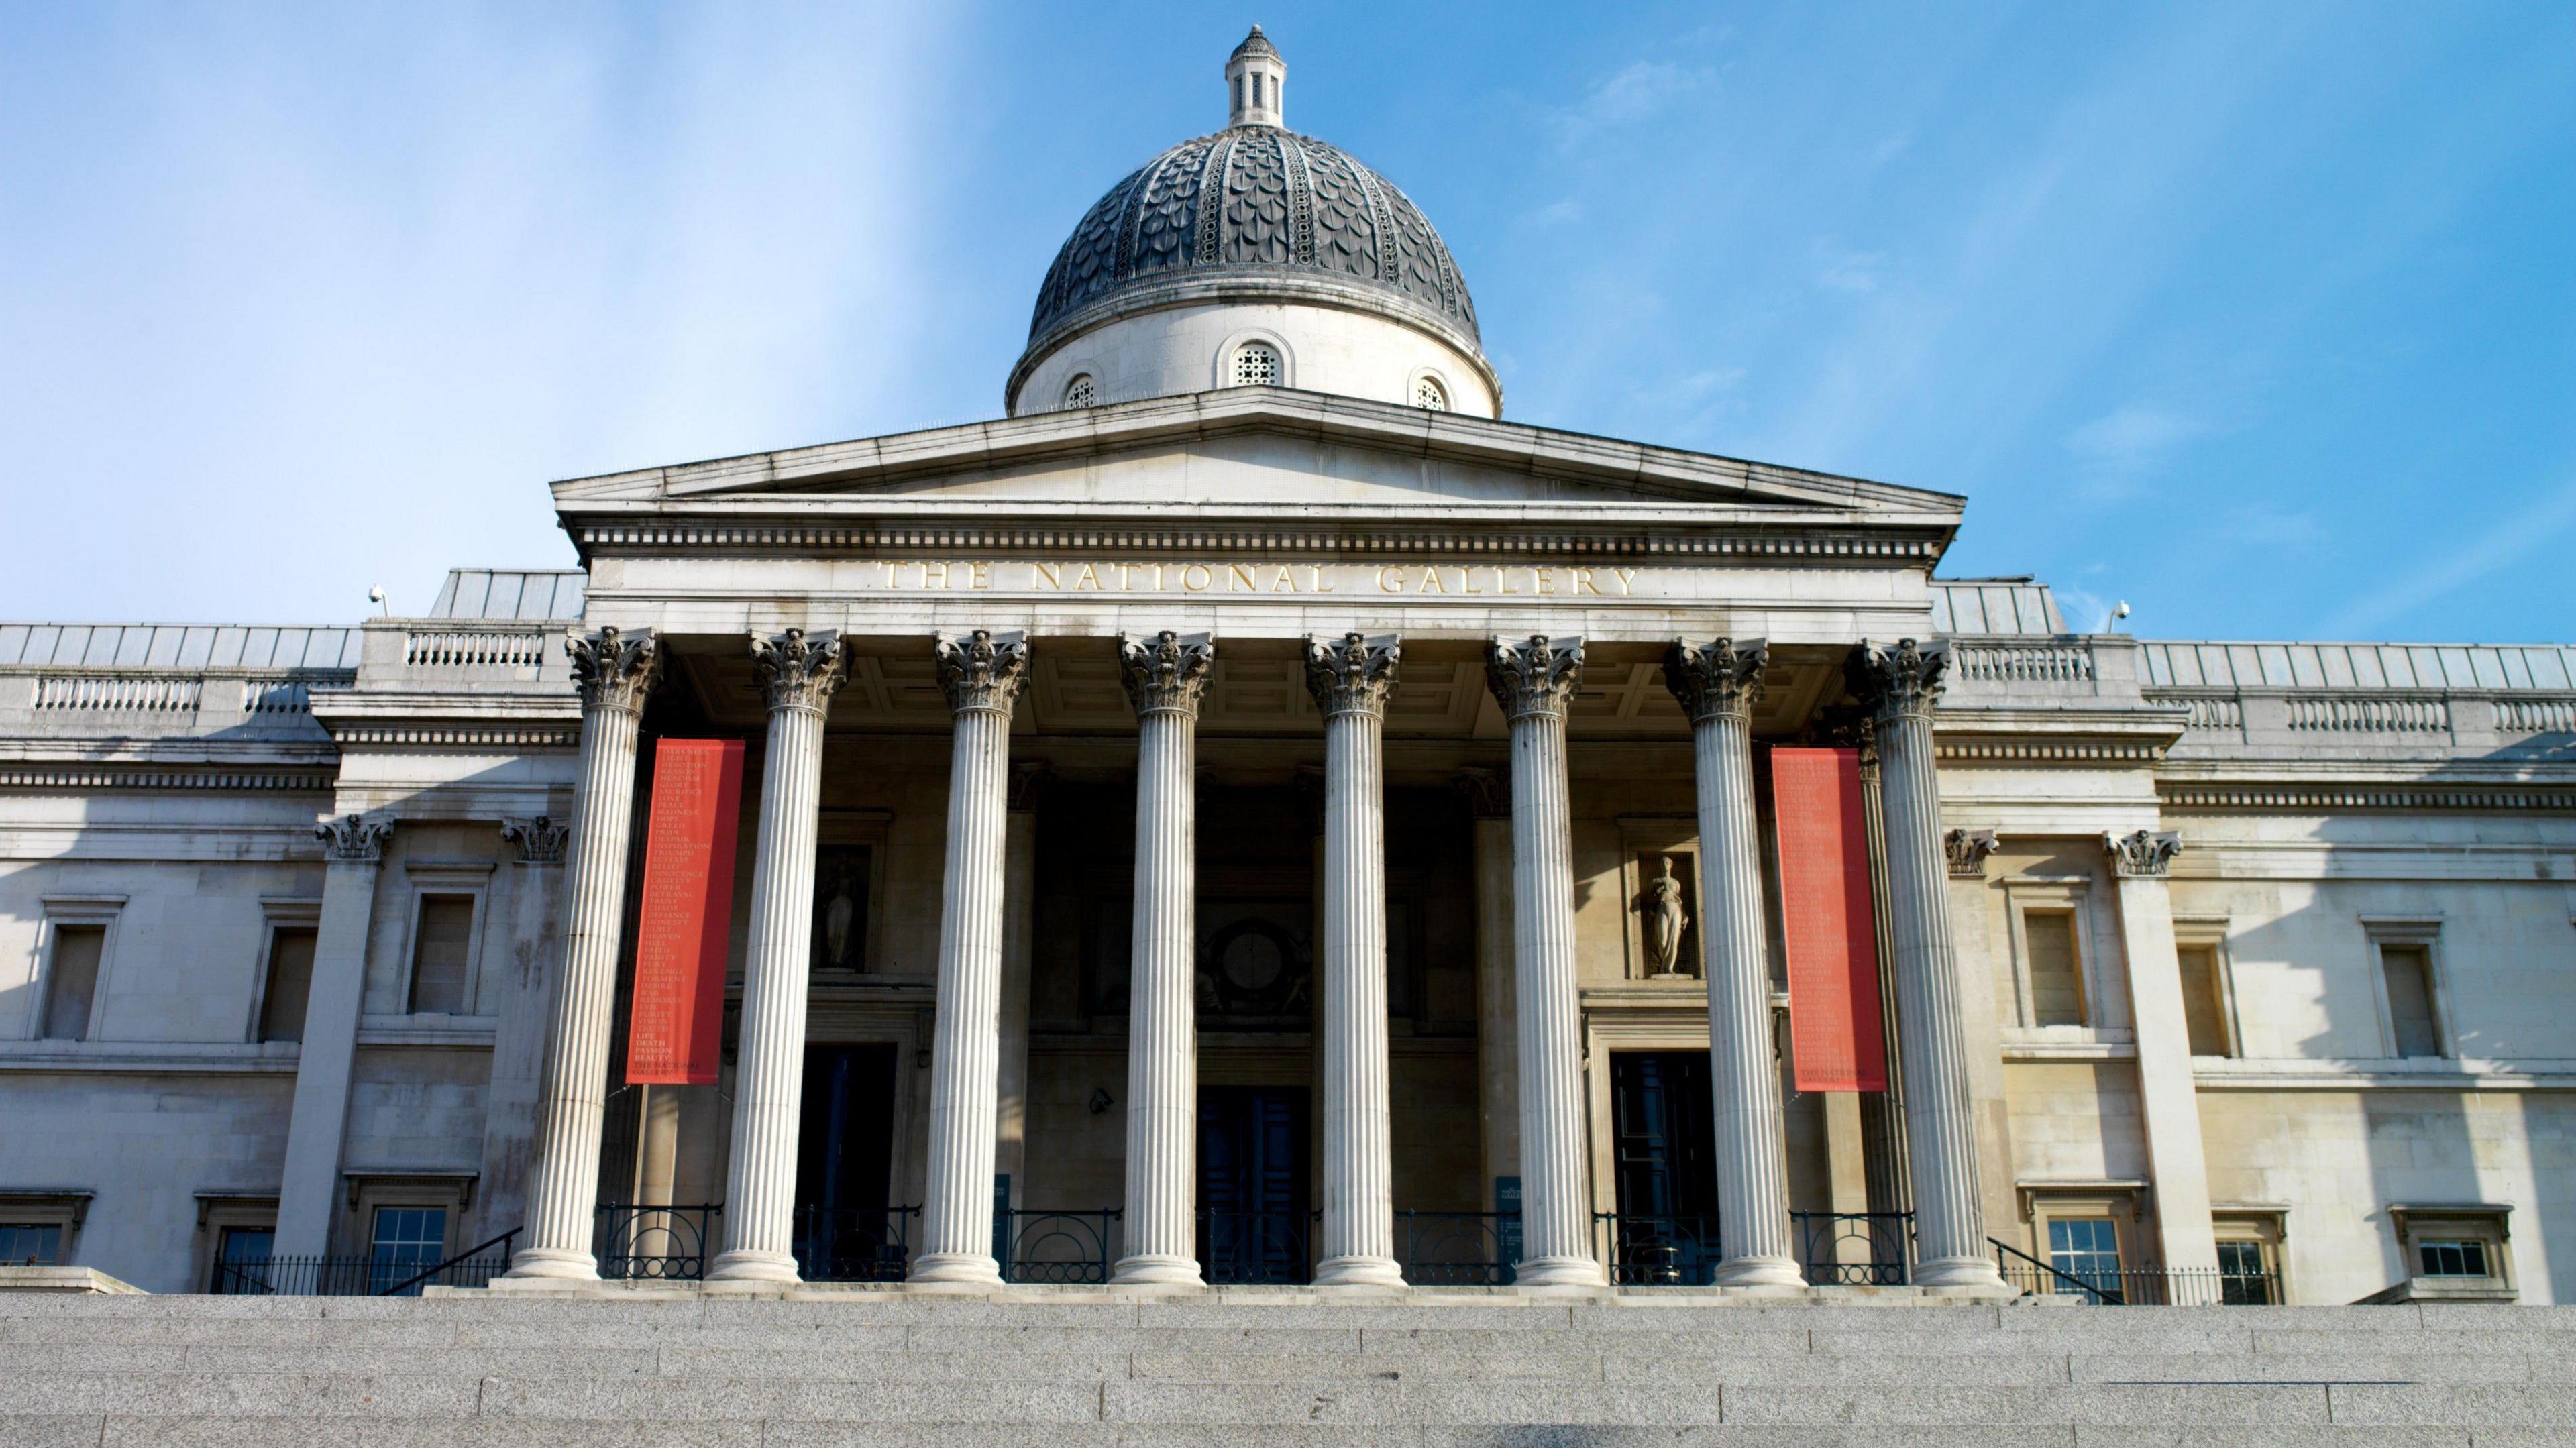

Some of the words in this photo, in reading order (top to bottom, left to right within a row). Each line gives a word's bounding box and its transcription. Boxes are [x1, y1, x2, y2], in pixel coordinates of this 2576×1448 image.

[877, 560, 989, 590] THE
[1030, 561, 1336, 594] NATIONAL
[1375, 565, 1641, 596] GALLERY
